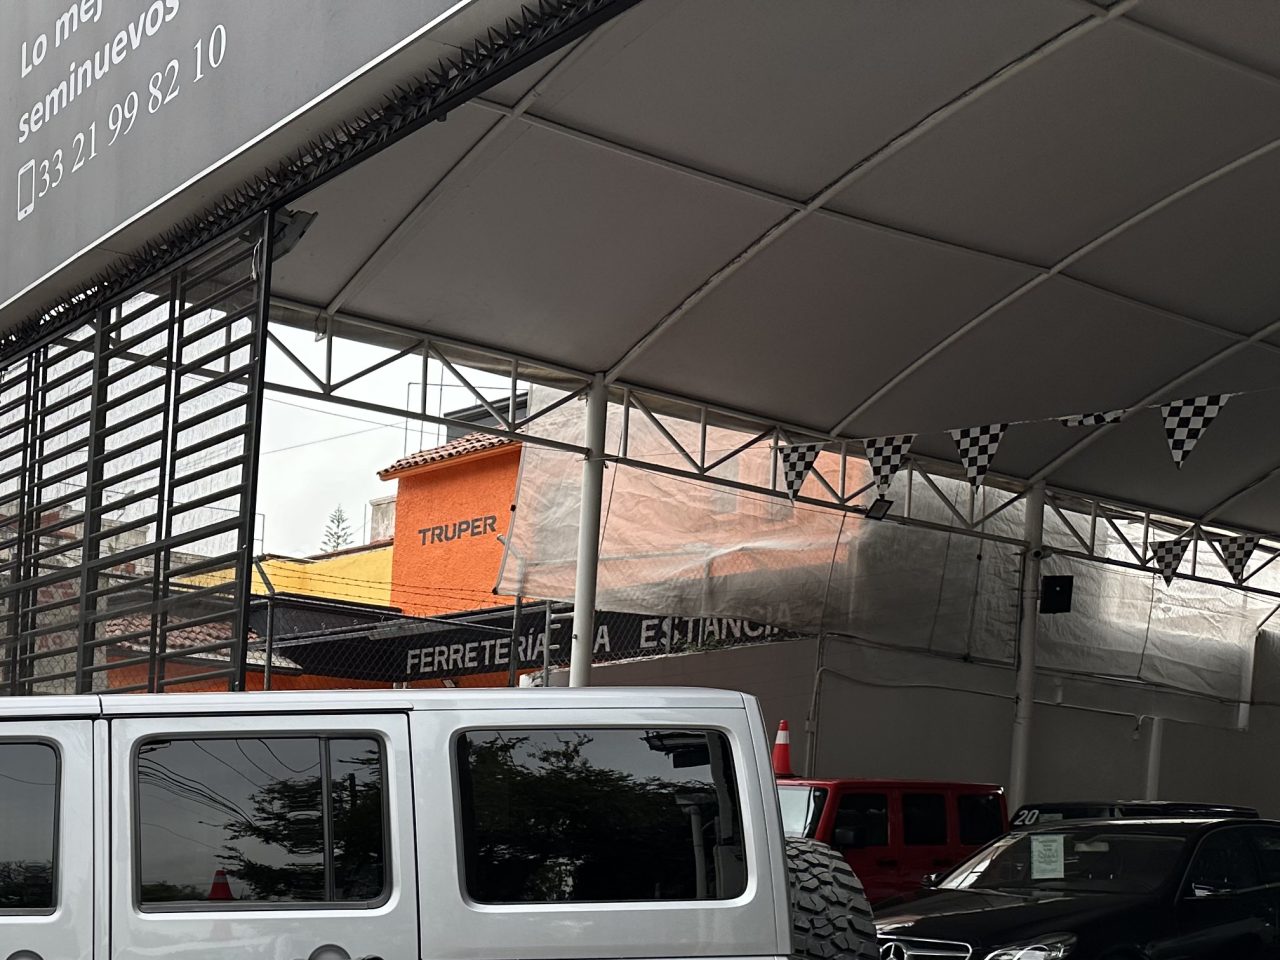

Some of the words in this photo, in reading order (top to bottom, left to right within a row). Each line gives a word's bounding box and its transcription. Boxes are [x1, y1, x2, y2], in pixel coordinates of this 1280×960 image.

[18, 0, 180, 144] seminuevos
[21, 33, 47, 78] Lo
[38, 148, 64, 198] 33
[71, 121, 98, 173] 21
[108, 91, 139, 146] 99
[148, 59, 180, 114] 82
[193, 24, 227, 83] 10
[418, 515, 497, 546] TRUPER
[407, 631, 547, 674] FERRETERÍA
[1014, 809, 1039, 825] 20
